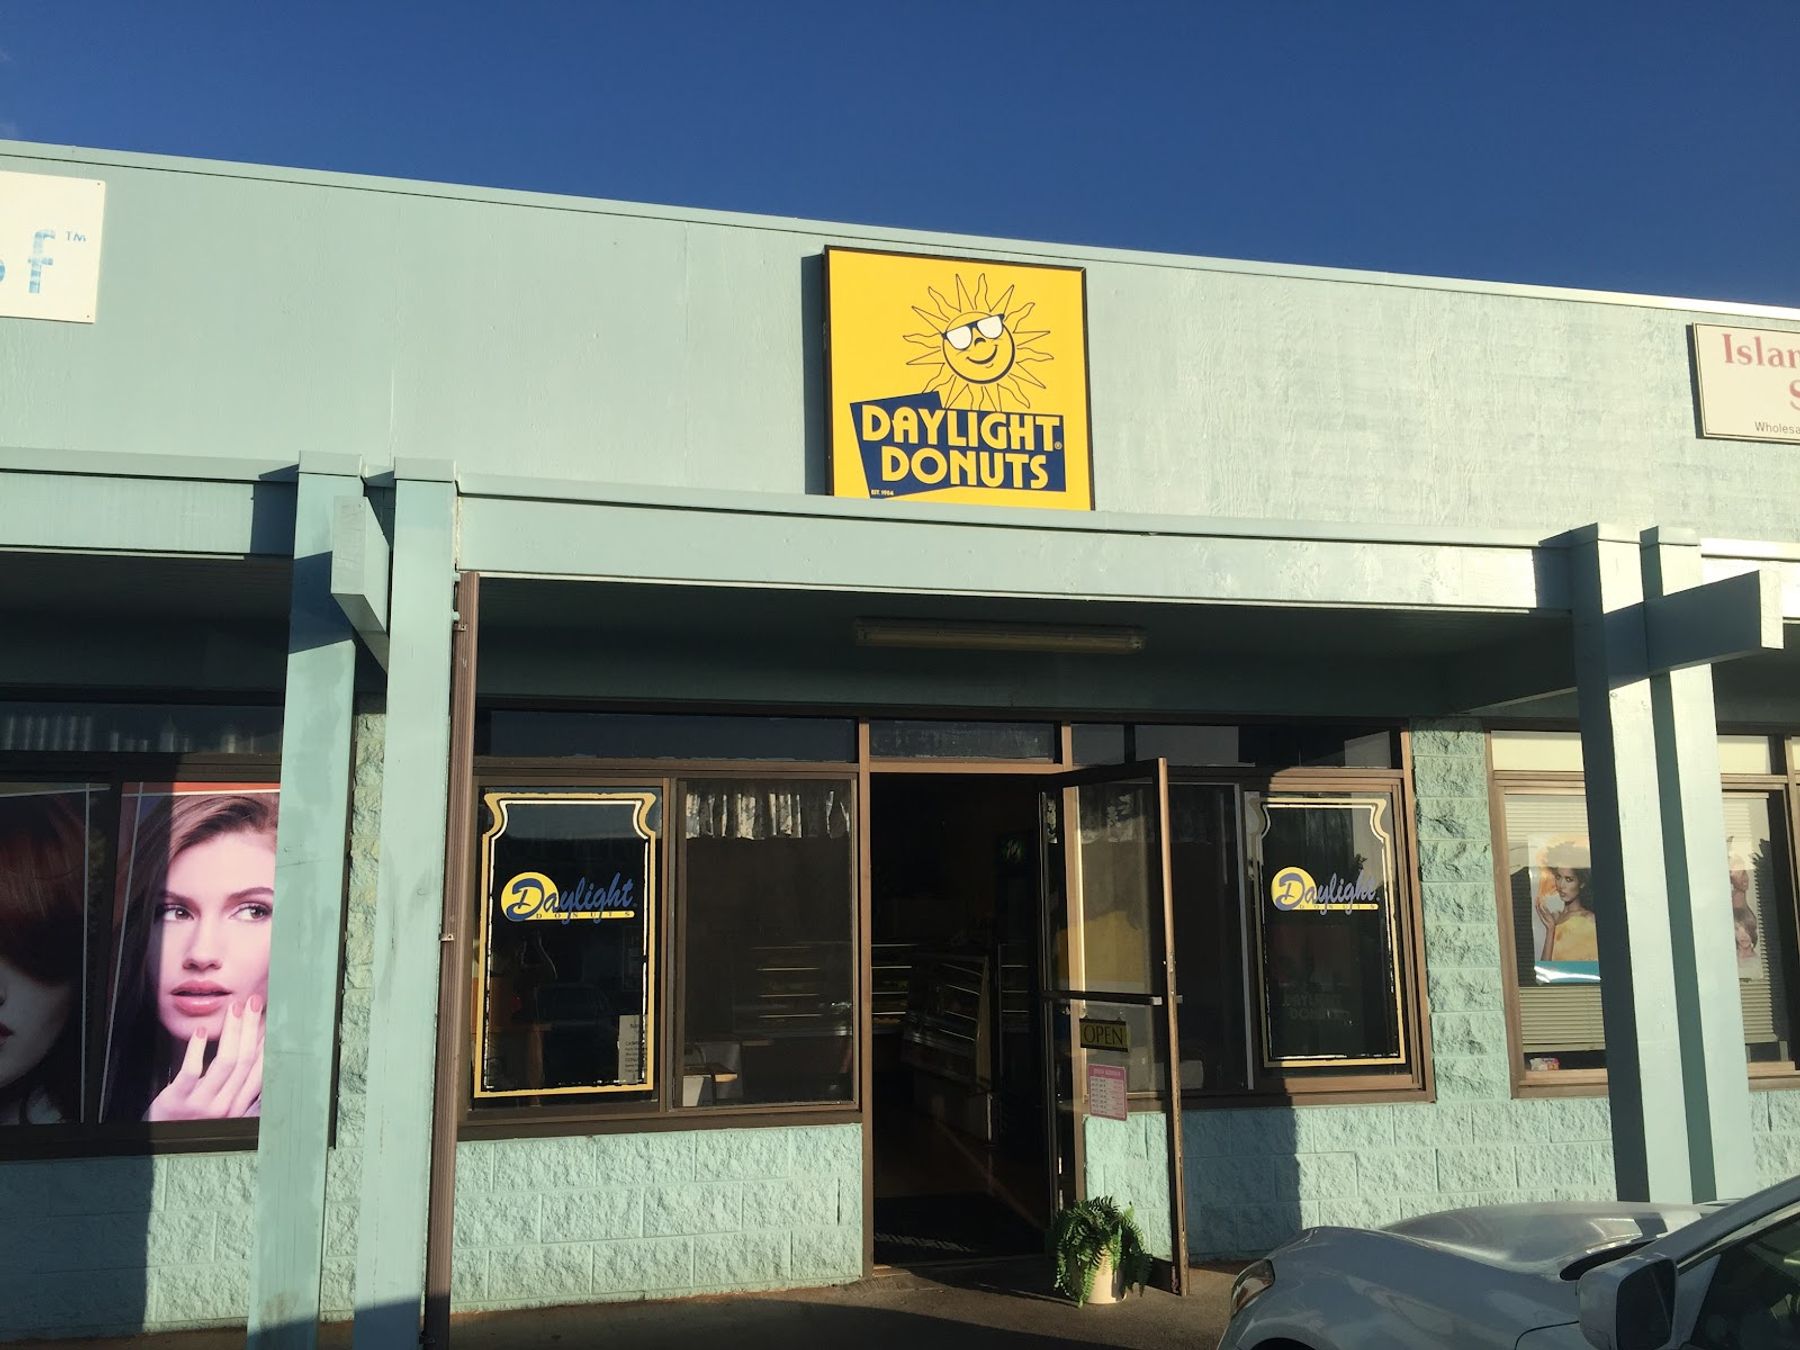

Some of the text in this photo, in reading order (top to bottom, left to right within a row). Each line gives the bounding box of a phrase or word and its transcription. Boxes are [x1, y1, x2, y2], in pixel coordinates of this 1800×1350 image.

[861, 404, 1060, 452] DAYLIGHT
[881, 445, 1049, 489] DONUTS
[506, 872, 634, 924] Daylight
[1275, 869, 1376, 915] Daylight
[536, 912, 631, 920] DONUTS
[1084, 1024, 1124, 1045] OPEN
